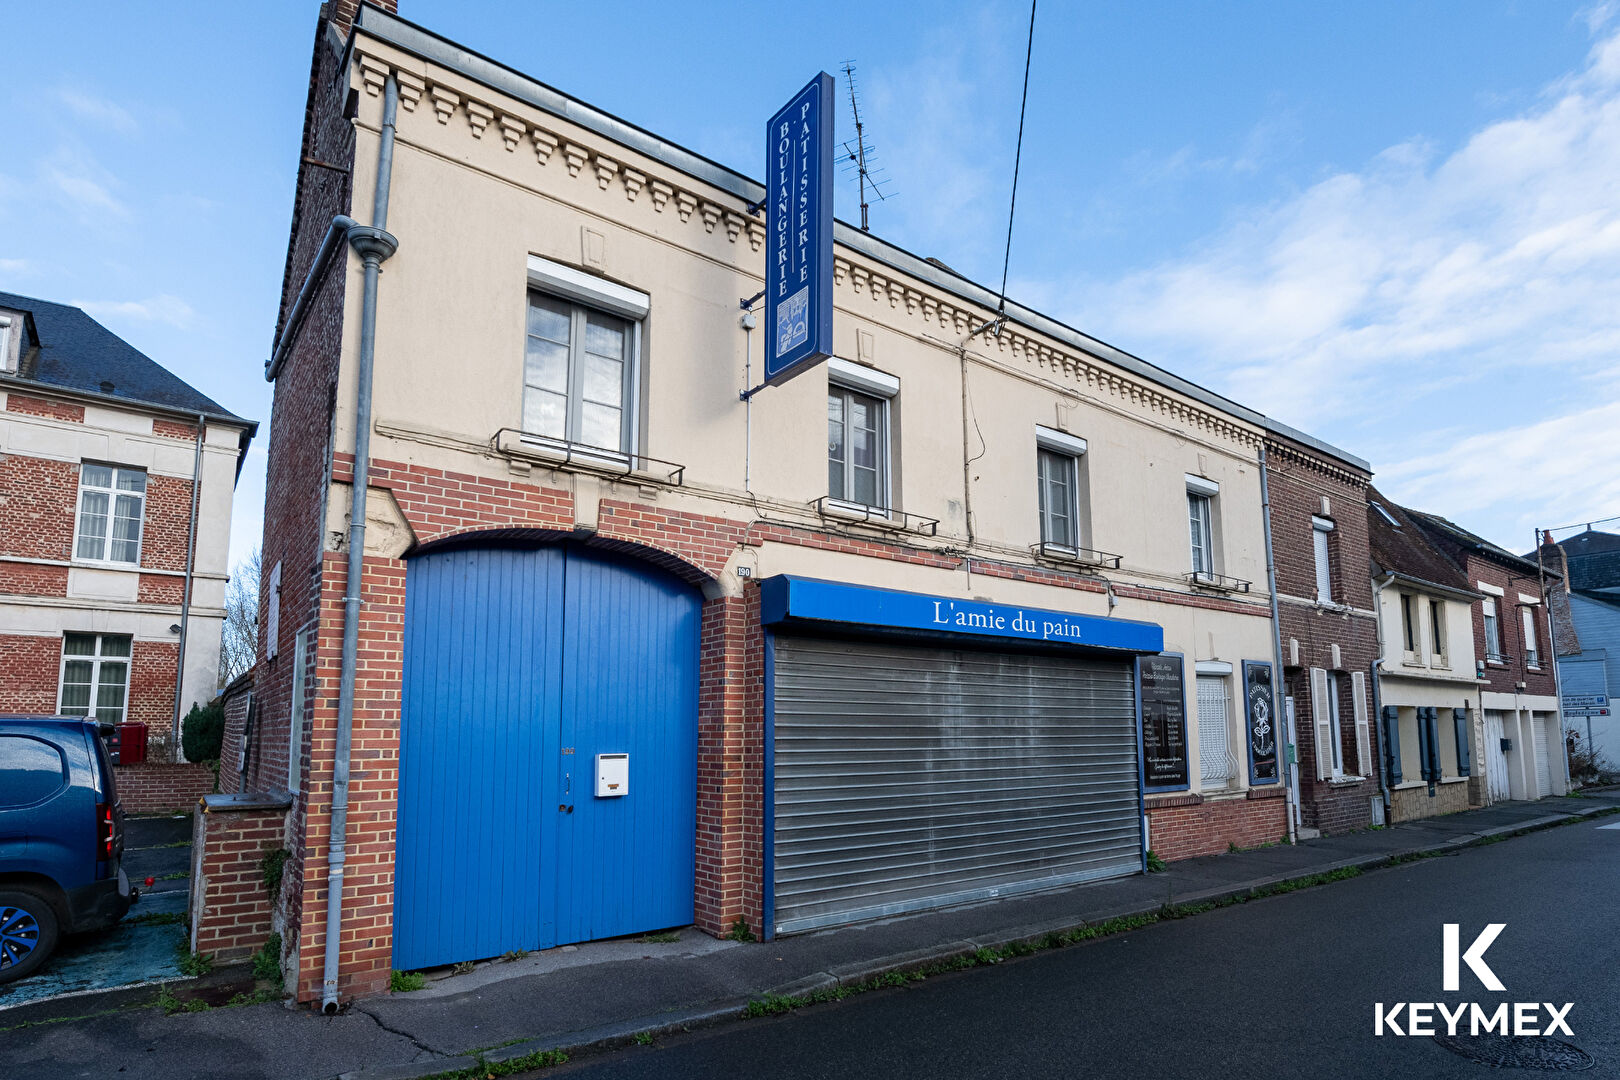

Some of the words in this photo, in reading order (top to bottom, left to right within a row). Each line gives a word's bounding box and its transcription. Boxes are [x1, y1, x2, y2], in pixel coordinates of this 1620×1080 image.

[777, 121, 790, 298] BOULANGERIE
[799, 102, 810, 284] PATISSERIE
[738, 567, 749, 576] 190
[932, 601, 1006, 630] L'amie
[1012, 611, 1037, 633] du
[1043, 618, 1081, 640] pain
